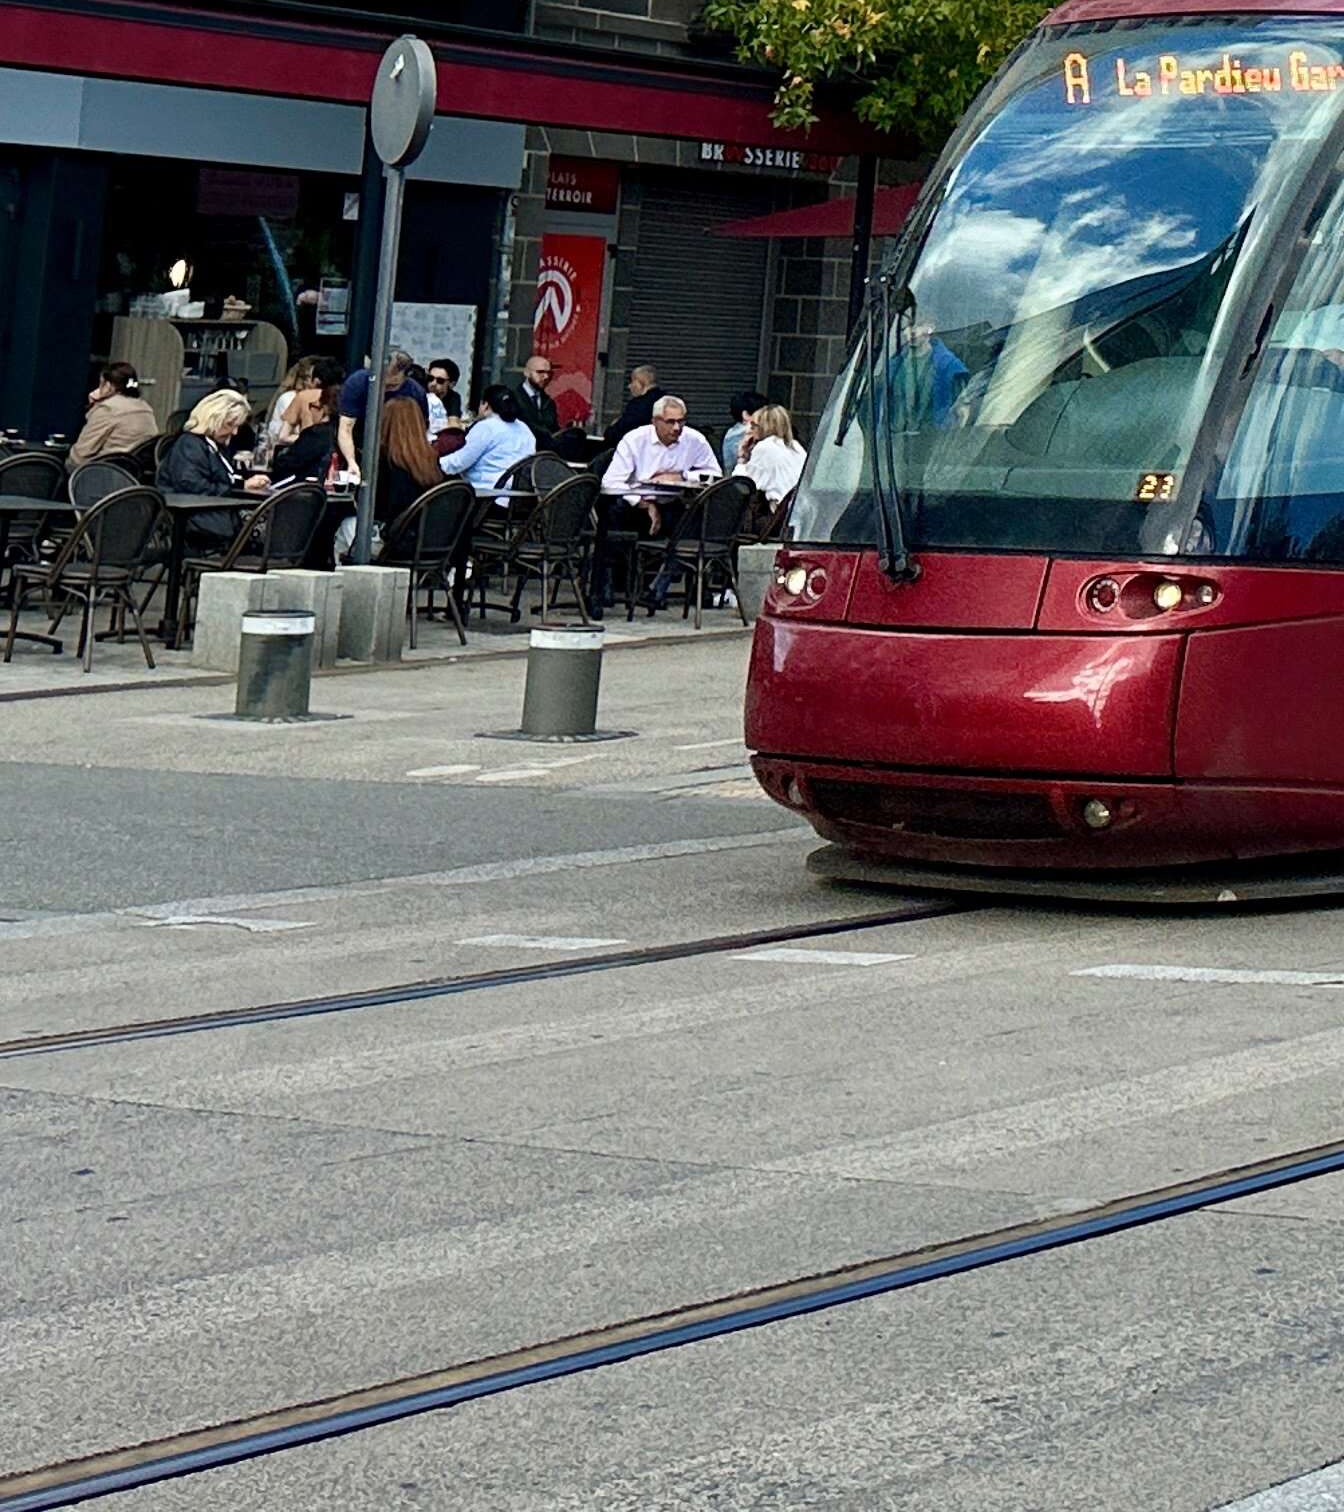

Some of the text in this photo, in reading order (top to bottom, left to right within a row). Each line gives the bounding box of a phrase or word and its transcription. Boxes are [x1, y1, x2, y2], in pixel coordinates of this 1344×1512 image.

[1063, 52, 1091, 104] A
[1116, 58, 1151, 96] La
[1158, 54, 1281, 95] Pardieu
[546, 188, 592, 204] TERROIR
[1139, 475, 1174, 499] 23
